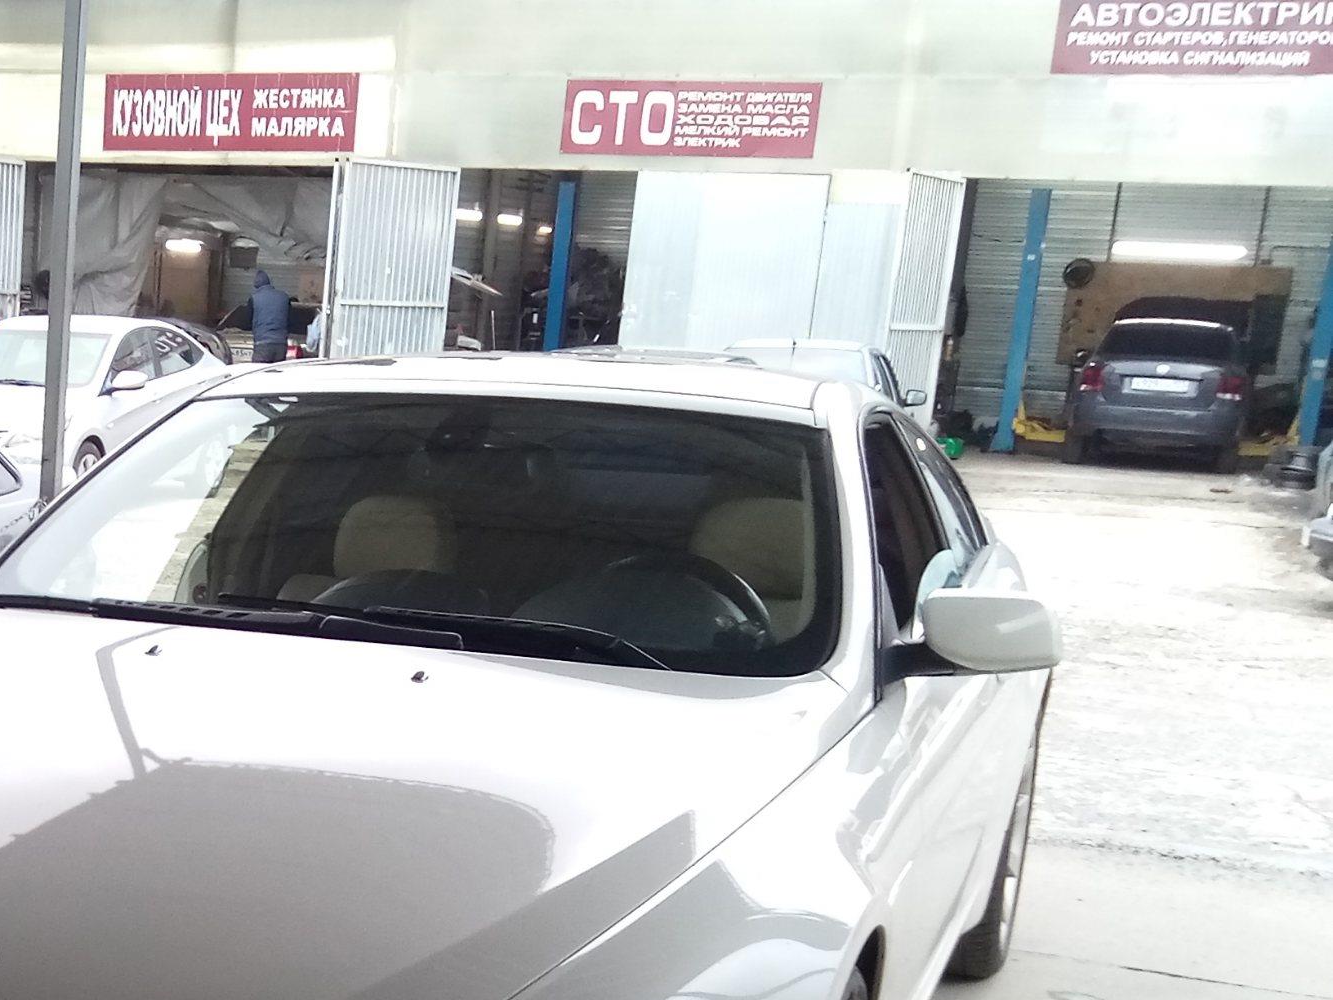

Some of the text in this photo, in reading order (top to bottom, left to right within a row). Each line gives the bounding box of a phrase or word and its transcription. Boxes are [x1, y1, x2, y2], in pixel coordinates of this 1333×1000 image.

[1066, 31, 1132, 46] РЕМОНТ
[1228, 31, 1333, 46] ГЕНЕРАТОРО
[1089, 50, 1179, 65] УСТАНОВКА
[252, 88, 346, 109] ЖЕСТЯНКА
[677, 91, 813, 103] РЕМОНТ ДВИГАТЕЛЯ
[112, 85, 243, 146] КУЗОВНОЙ ЦЕХ
[677, 103, 810, 114] ЗАМЕНА МАСЛА
[570, 90, 675, 146] СТО
[676, 114, 810, 126] ХОДОВАЯ
[251, 116, 345, 137] МАЛЯРКА
[674, 124, 810, 137] МЕЛКИЙ РЕМОНТ
[673, 137, 742, 147] ЭЛЕКТРИК
